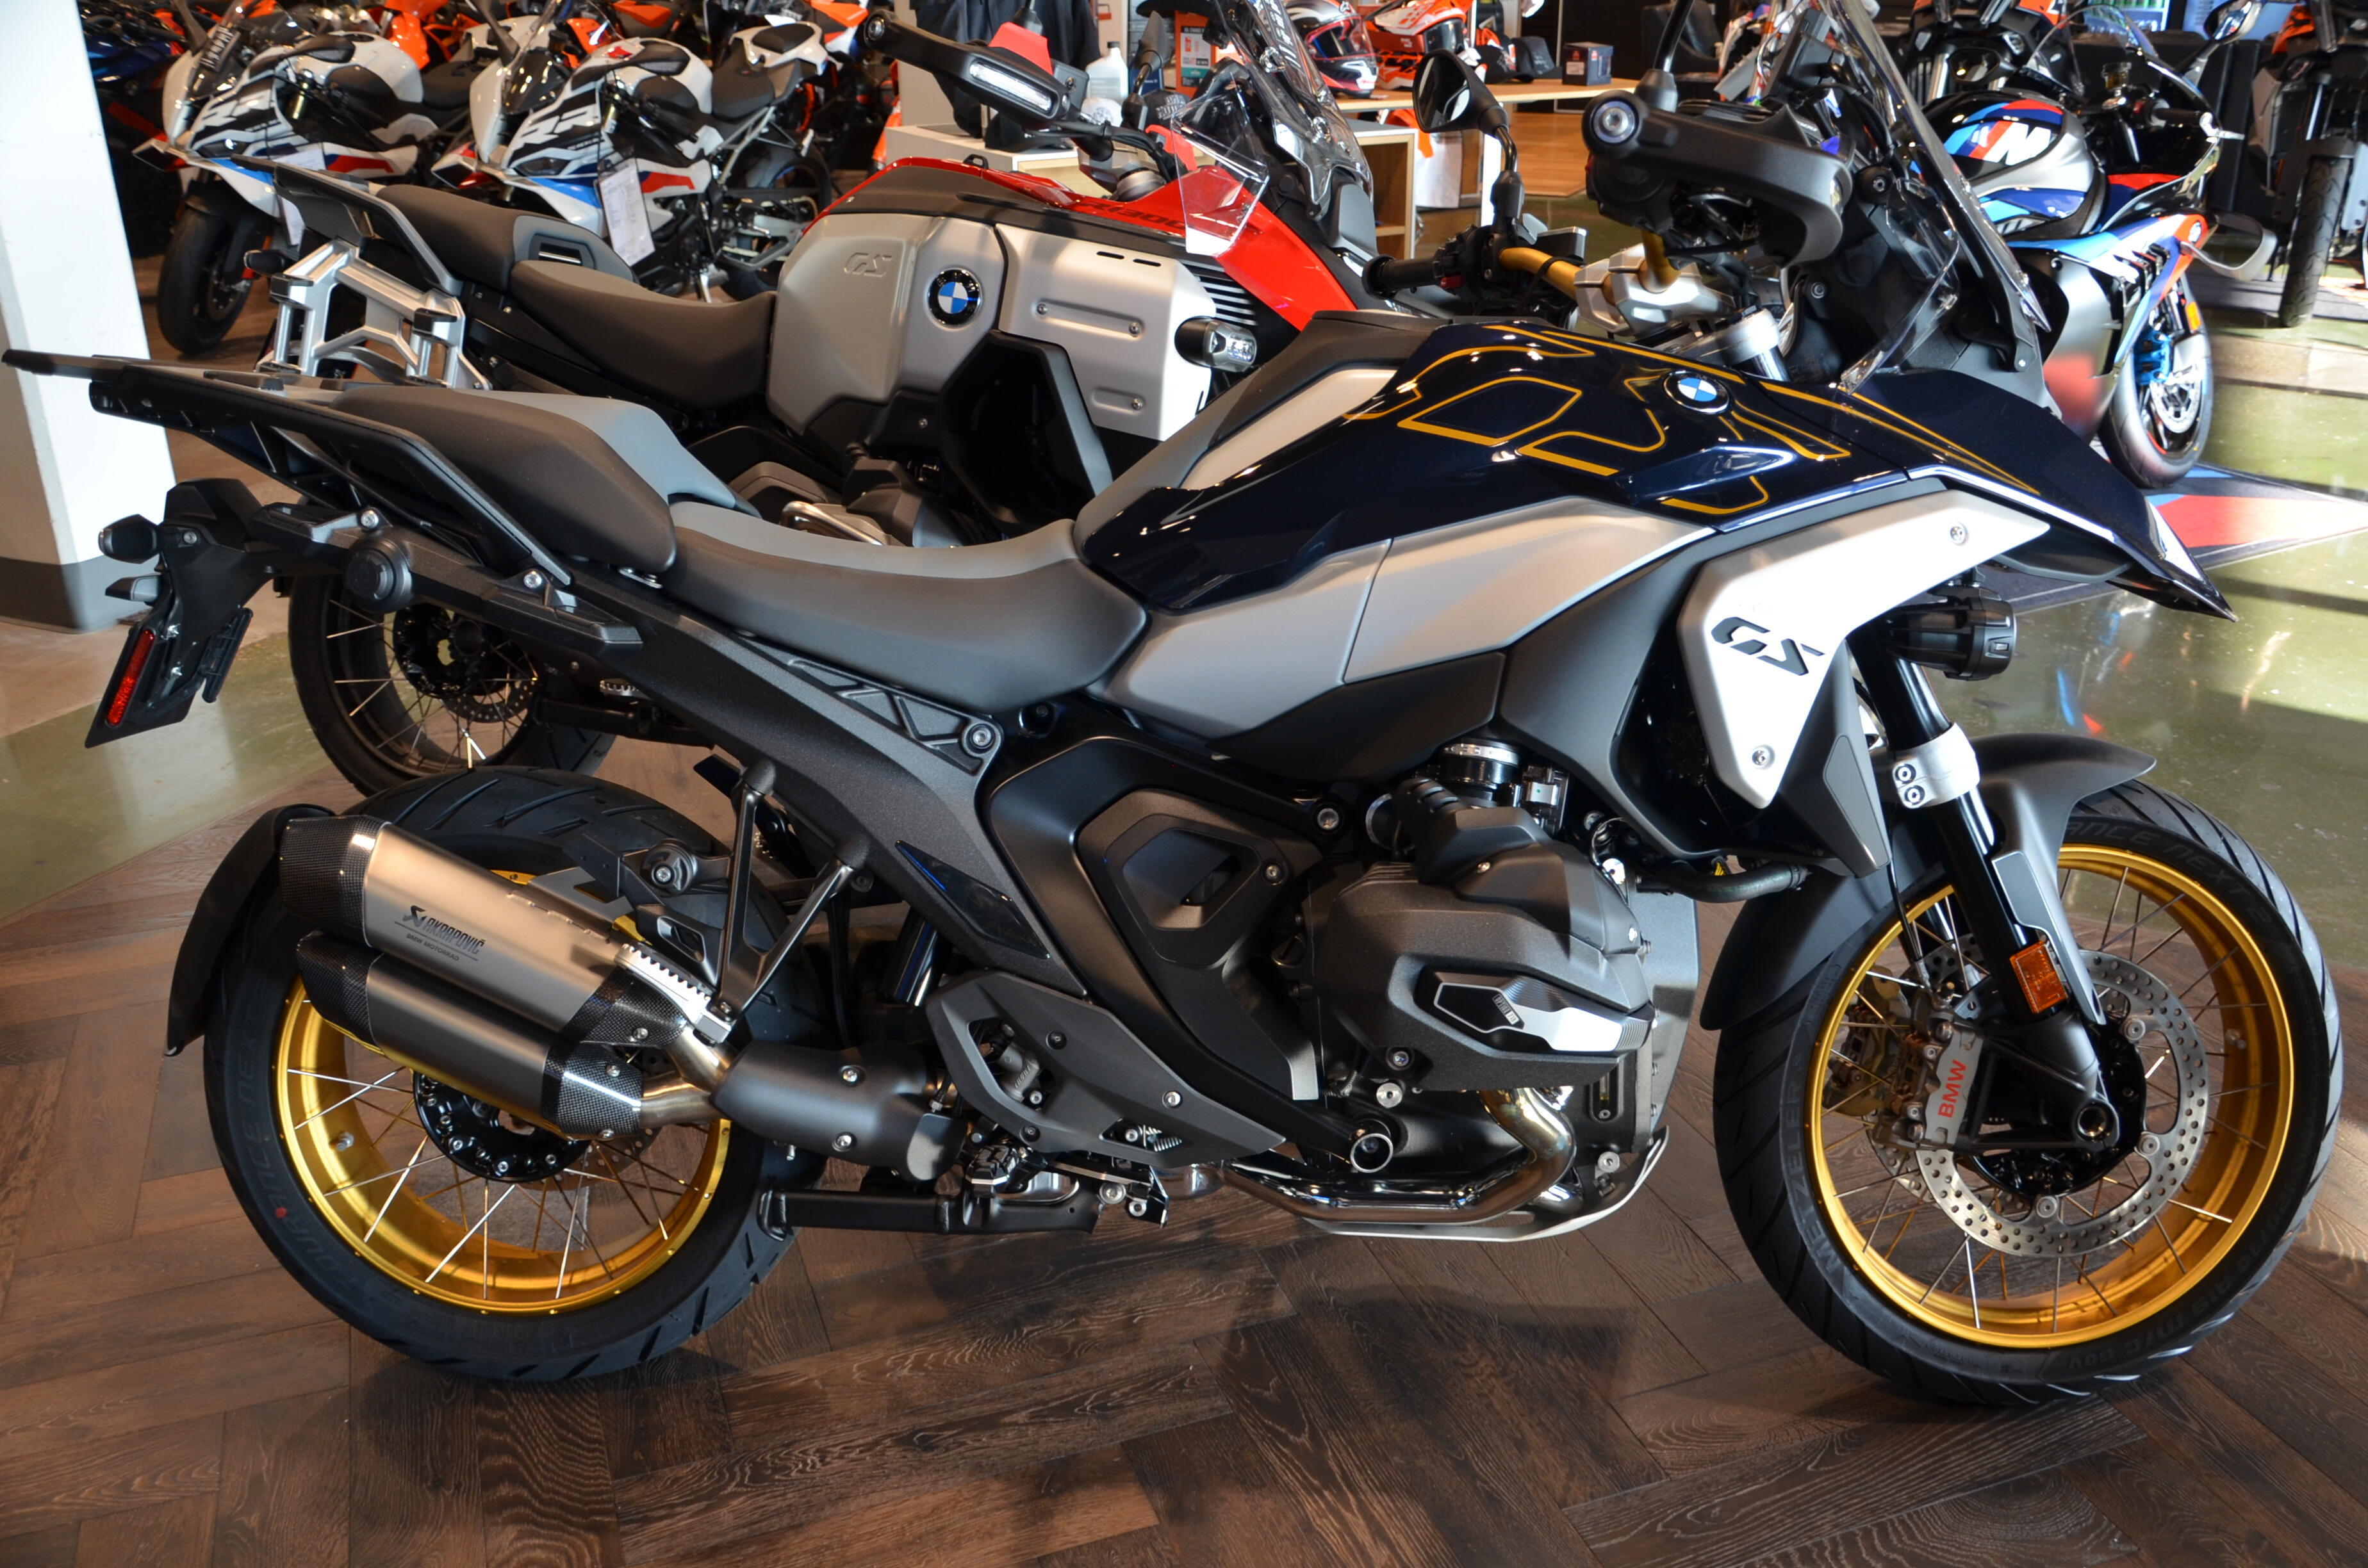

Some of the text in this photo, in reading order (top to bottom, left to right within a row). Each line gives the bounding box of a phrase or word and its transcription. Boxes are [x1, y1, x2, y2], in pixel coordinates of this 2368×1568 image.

[844, 252, 892, 277] GS
[1711, 617, 1825, 676] GS
[406, 933, 459, 961] BMW MOTORRAD
[1937, 1059, 1968, 1118] BMW
[1784, 1081, 1845, 1277] METZELER
